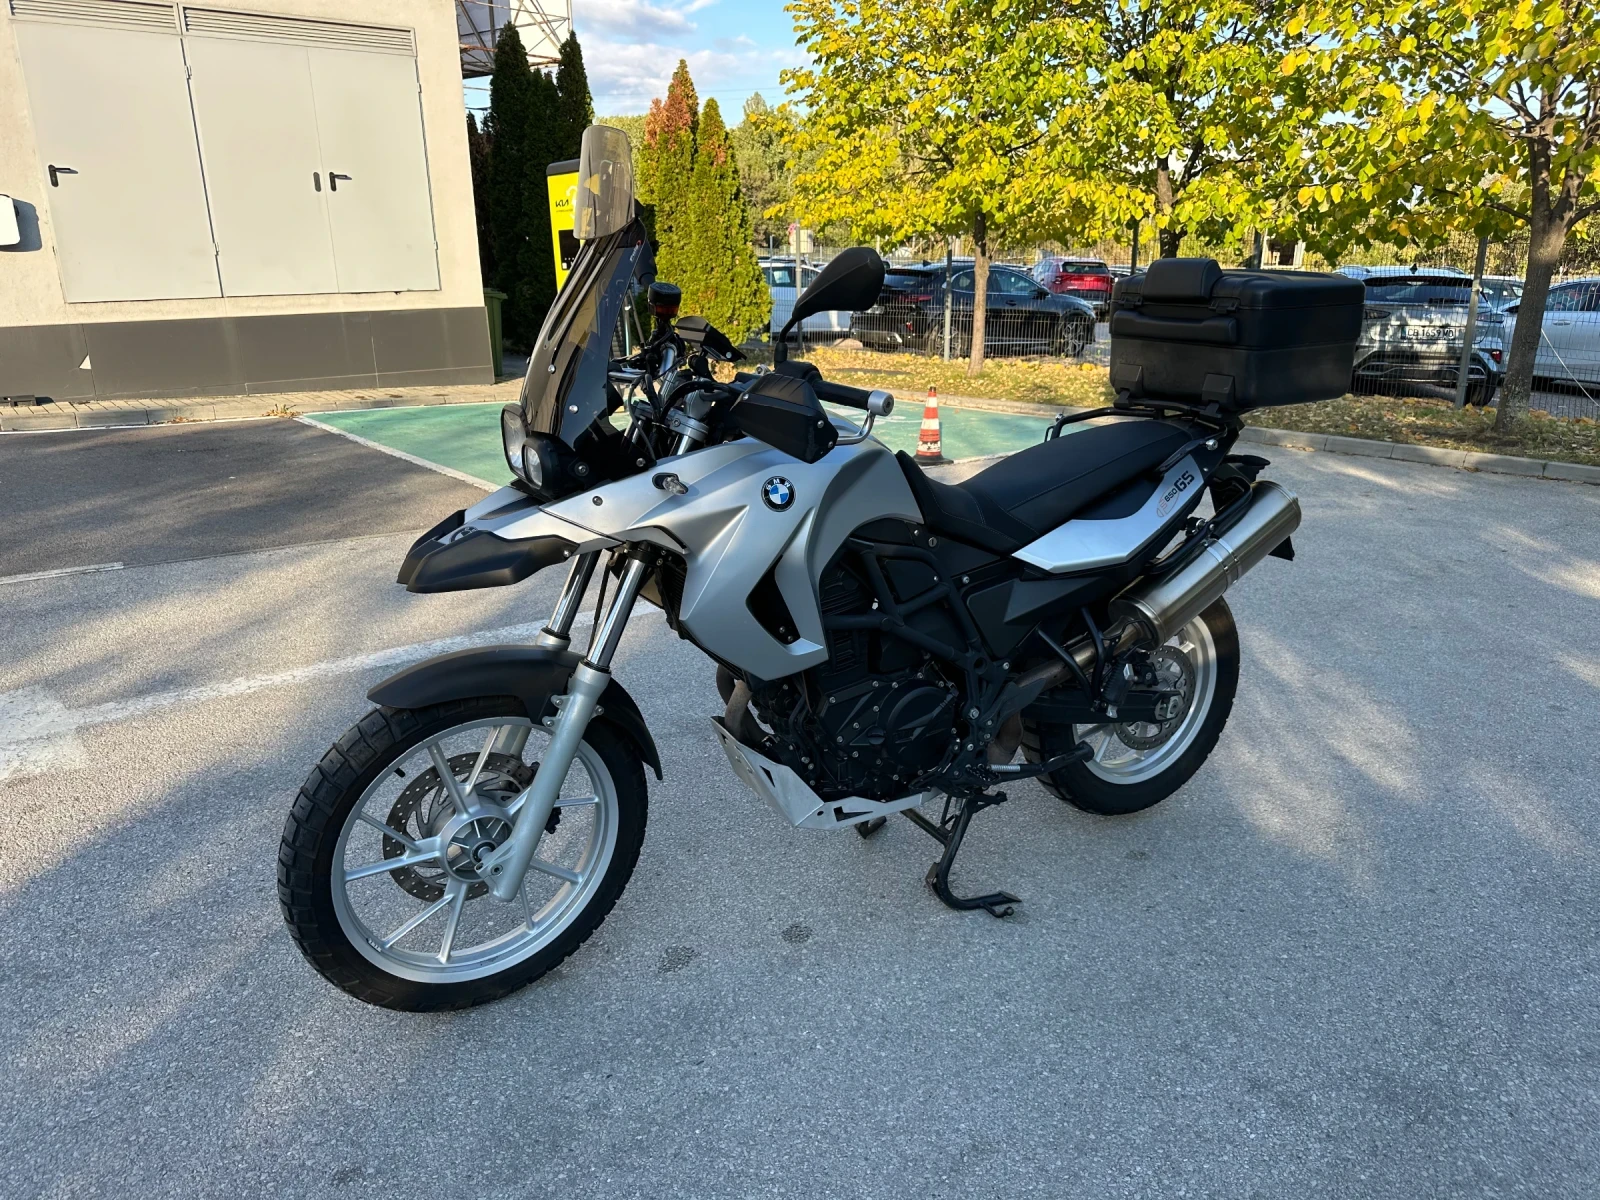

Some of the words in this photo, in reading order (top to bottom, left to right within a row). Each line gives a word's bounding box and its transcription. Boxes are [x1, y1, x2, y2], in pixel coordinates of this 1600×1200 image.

[555, 199, 569, 207] KIA
[1407, 328, 1419, 337] CB
[1421, 328, 1441, 337] 1659
[765, 478, 791, 490] BMW
[1173, 470, 1195, 492] GS
